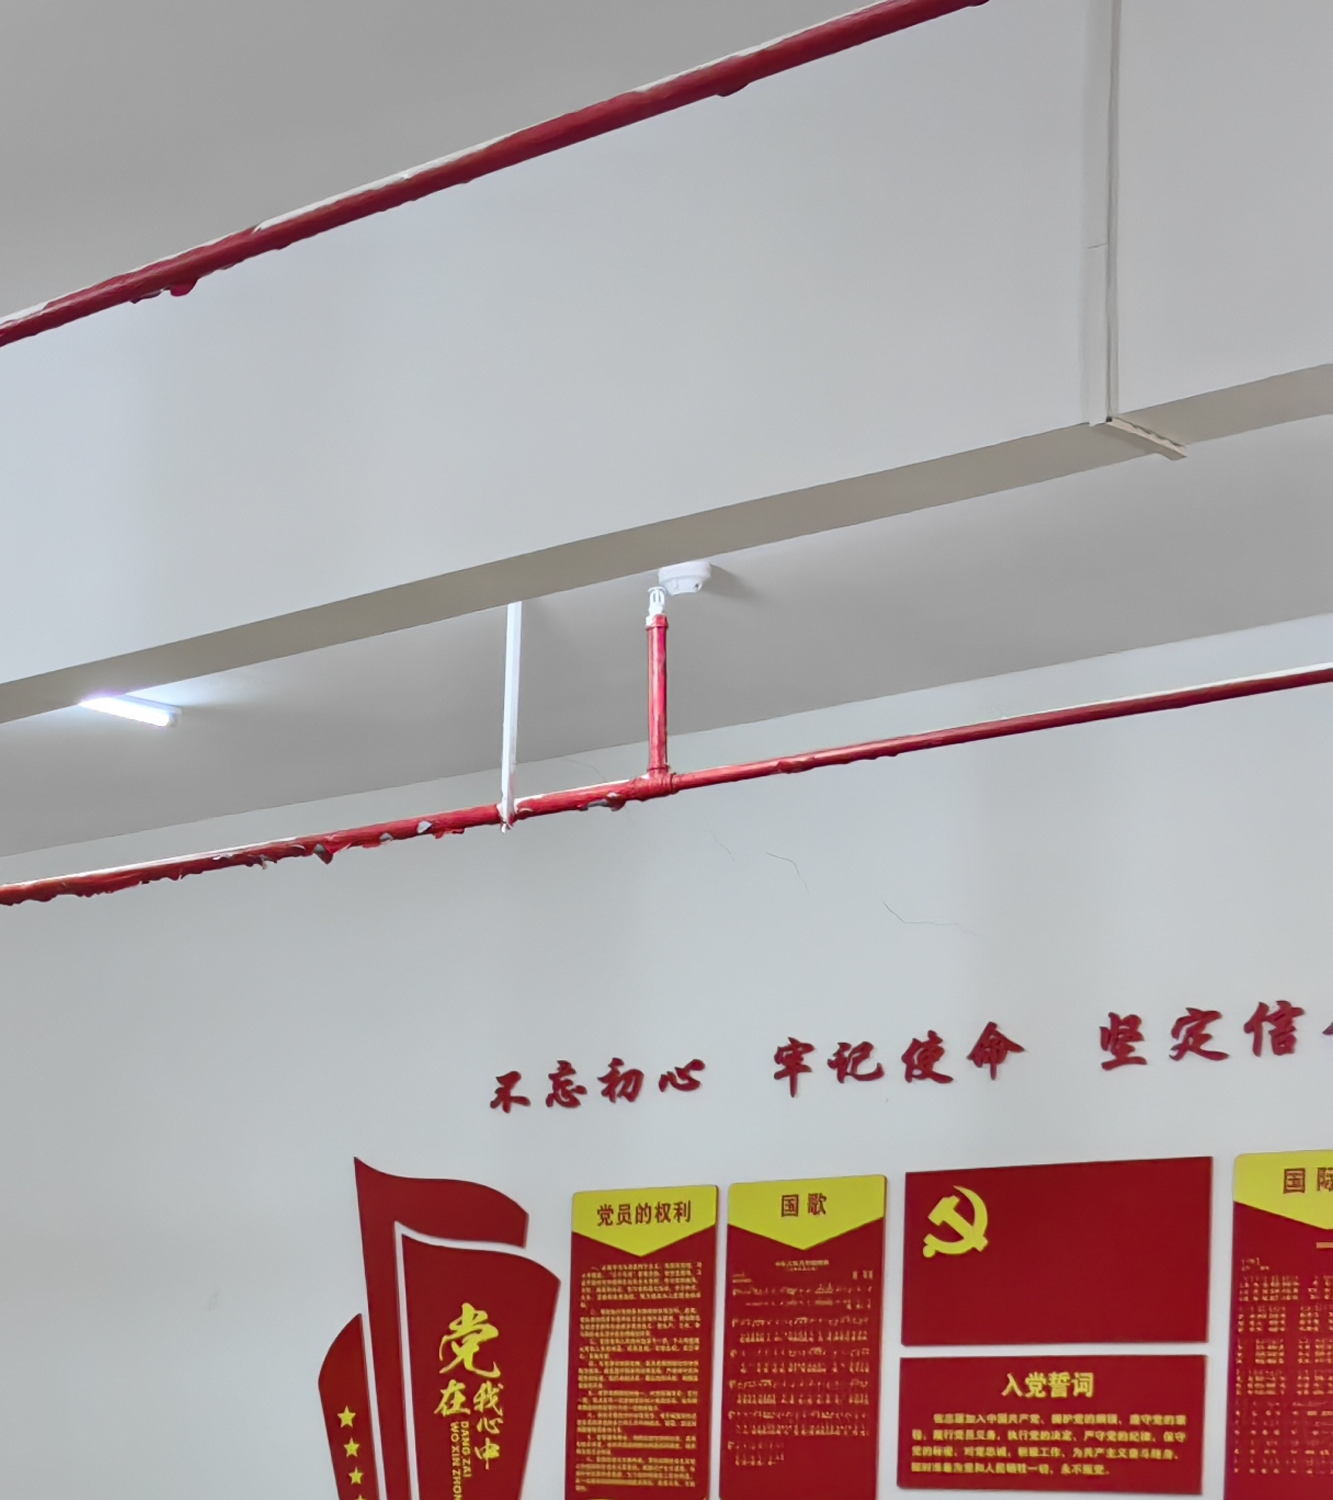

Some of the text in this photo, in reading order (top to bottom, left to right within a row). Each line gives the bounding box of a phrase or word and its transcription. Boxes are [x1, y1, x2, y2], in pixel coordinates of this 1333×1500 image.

[490, 1000, 1333, 1114] 不忘初心 牢记使命 坚定信
[597, 1200, 691, 1226] 党员的权利
[781, 1193, 827, 1217] 国歌
[439, 1302, 501, 1378] 党
[434, 1379, 471, 1416] 在
[1000, 1372, 1095, 1398] 入党誓词
[450, 1421, 460, 1442] WO
[473, 1380, 504, 1470] 我心中
[451, 1444, 461, 1467] XIN
[460, 1421, 472, 1478] DANG ZAI
